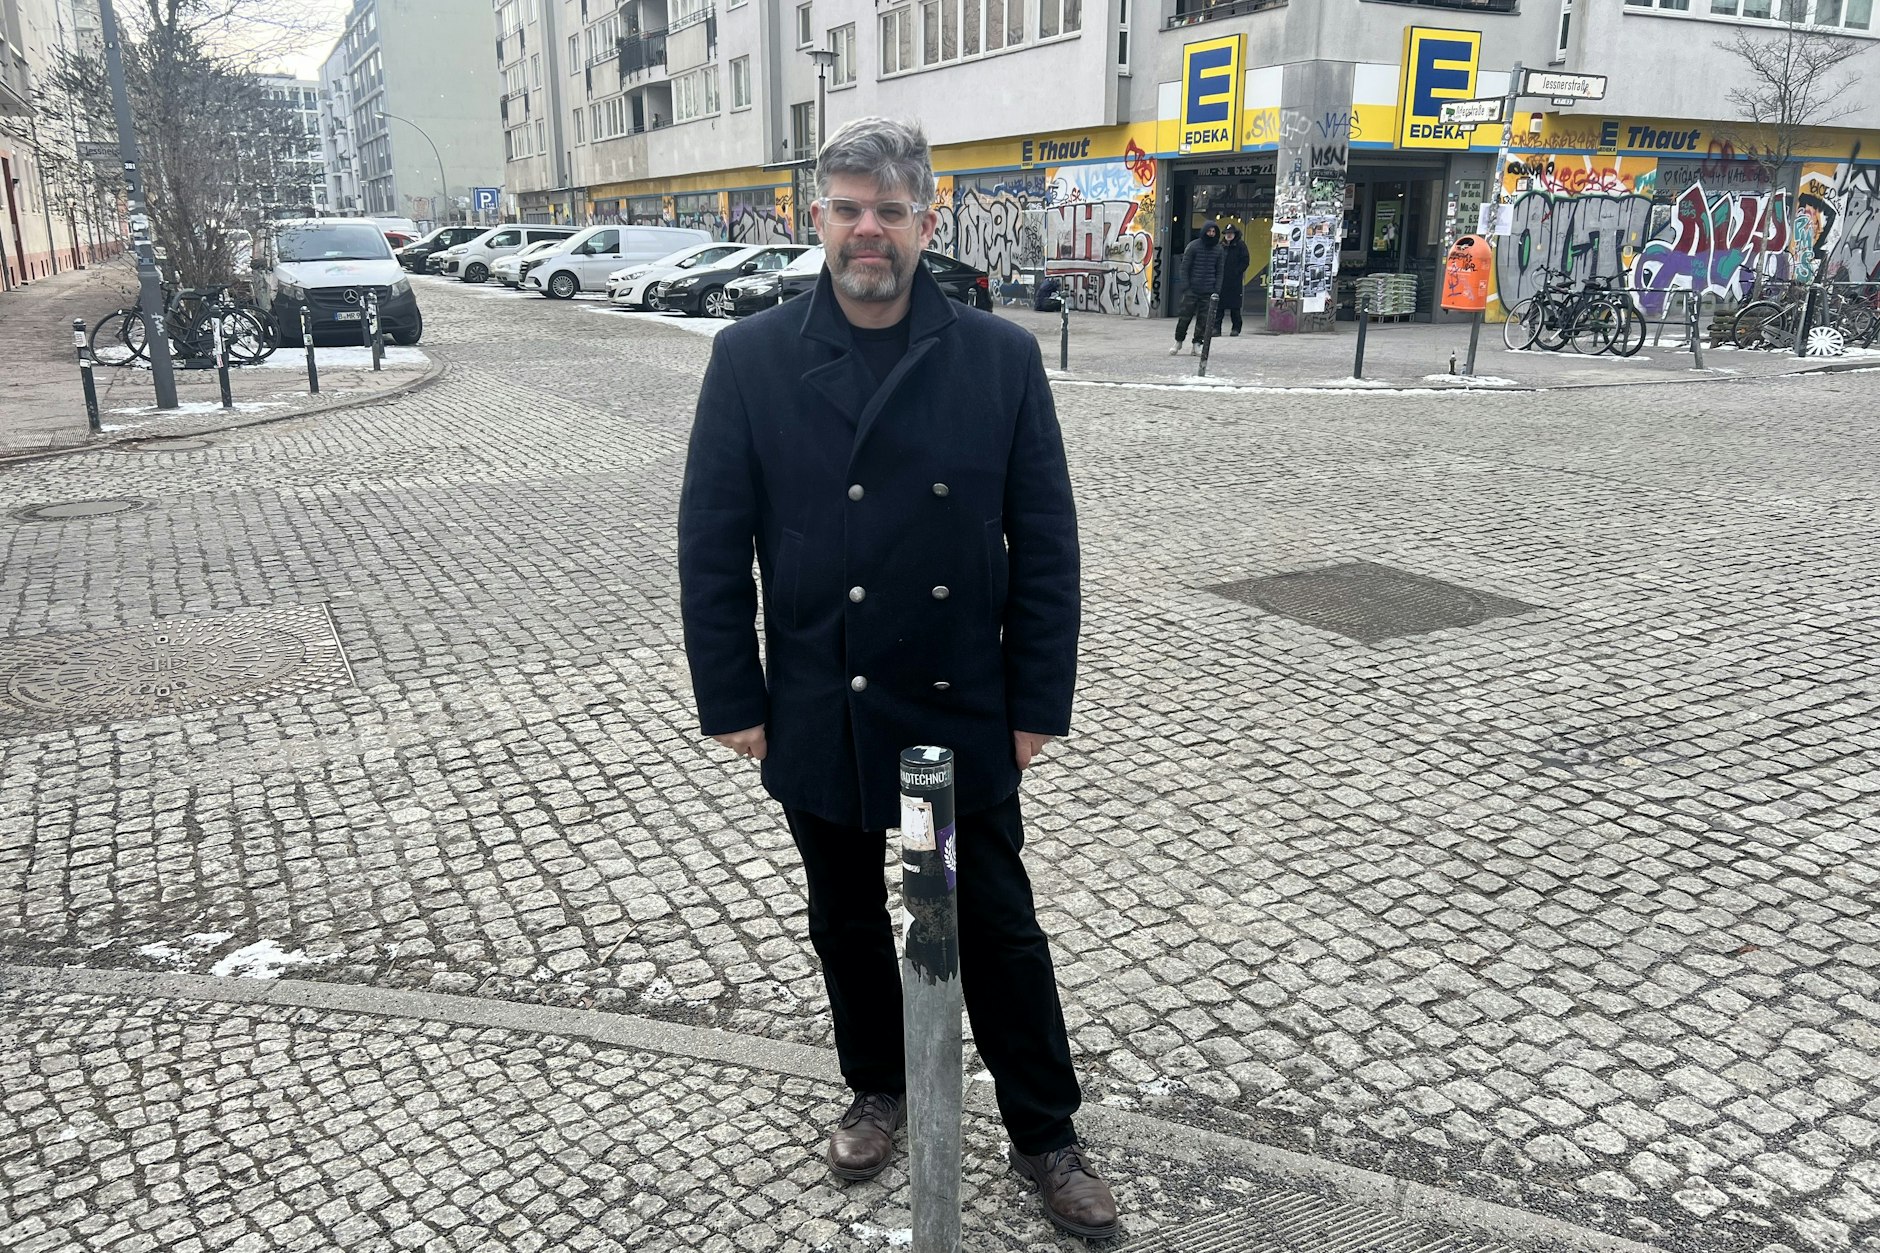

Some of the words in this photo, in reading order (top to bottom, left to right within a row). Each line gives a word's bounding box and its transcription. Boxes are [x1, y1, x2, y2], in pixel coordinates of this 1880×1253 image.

[1543, 77, 1590, 92] Jessnerstraße
[1185, 128, 1229, 145] EDEKA
[1409, 124, 1465, 140] EDEKA
[1627, 126, 1702, 151] Thaut
[1038, 137, 1091, 161] Thaut
[1260, 164, 1276, 175] 22.0
[480, 192, 492, 209] P
